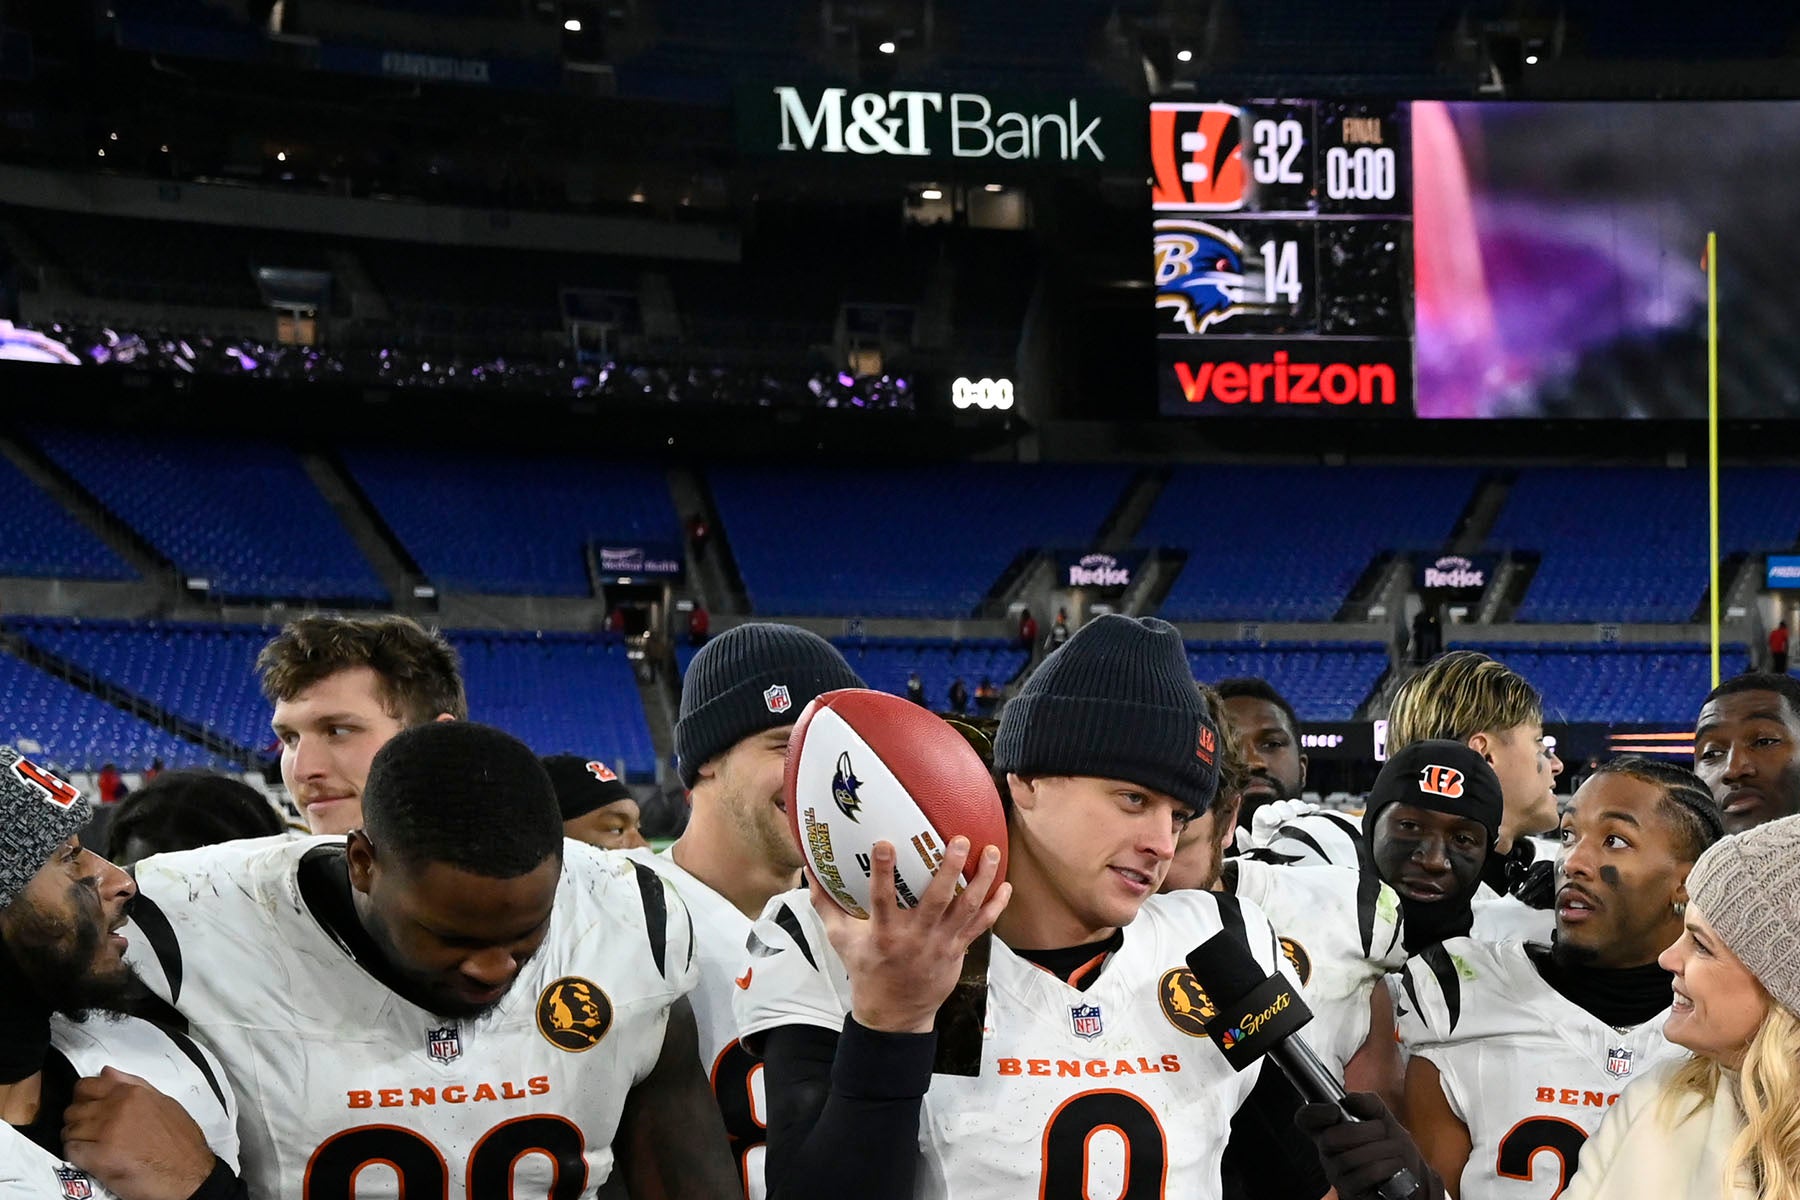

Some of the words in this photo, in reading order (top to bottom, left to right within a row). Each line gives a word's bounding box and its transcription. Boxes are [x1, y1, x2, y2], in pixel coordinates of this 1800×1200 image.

[773, 86, 942, 155] M&T
[950, 92, 1105, 161] Bank
[1342, 117, 1383, 144] FINAL
[1252, 119, 1304, 184] 32
[1326, 147, 1396, 200] 0:00
[1260, 240, 1303, 303] 14
[951, 376, 1015, 411] 0:00
[1175, 352, 1396, 406] verizon
[804, 807, 827, 876] FOOTBALL
[816, 822, 835, 863] GAME
[1239, 992, 1291, 1036] Sports
[997, 1053, 1182, 1078] BENGALS
[347, 1075, 551, 1109] BENGALS
